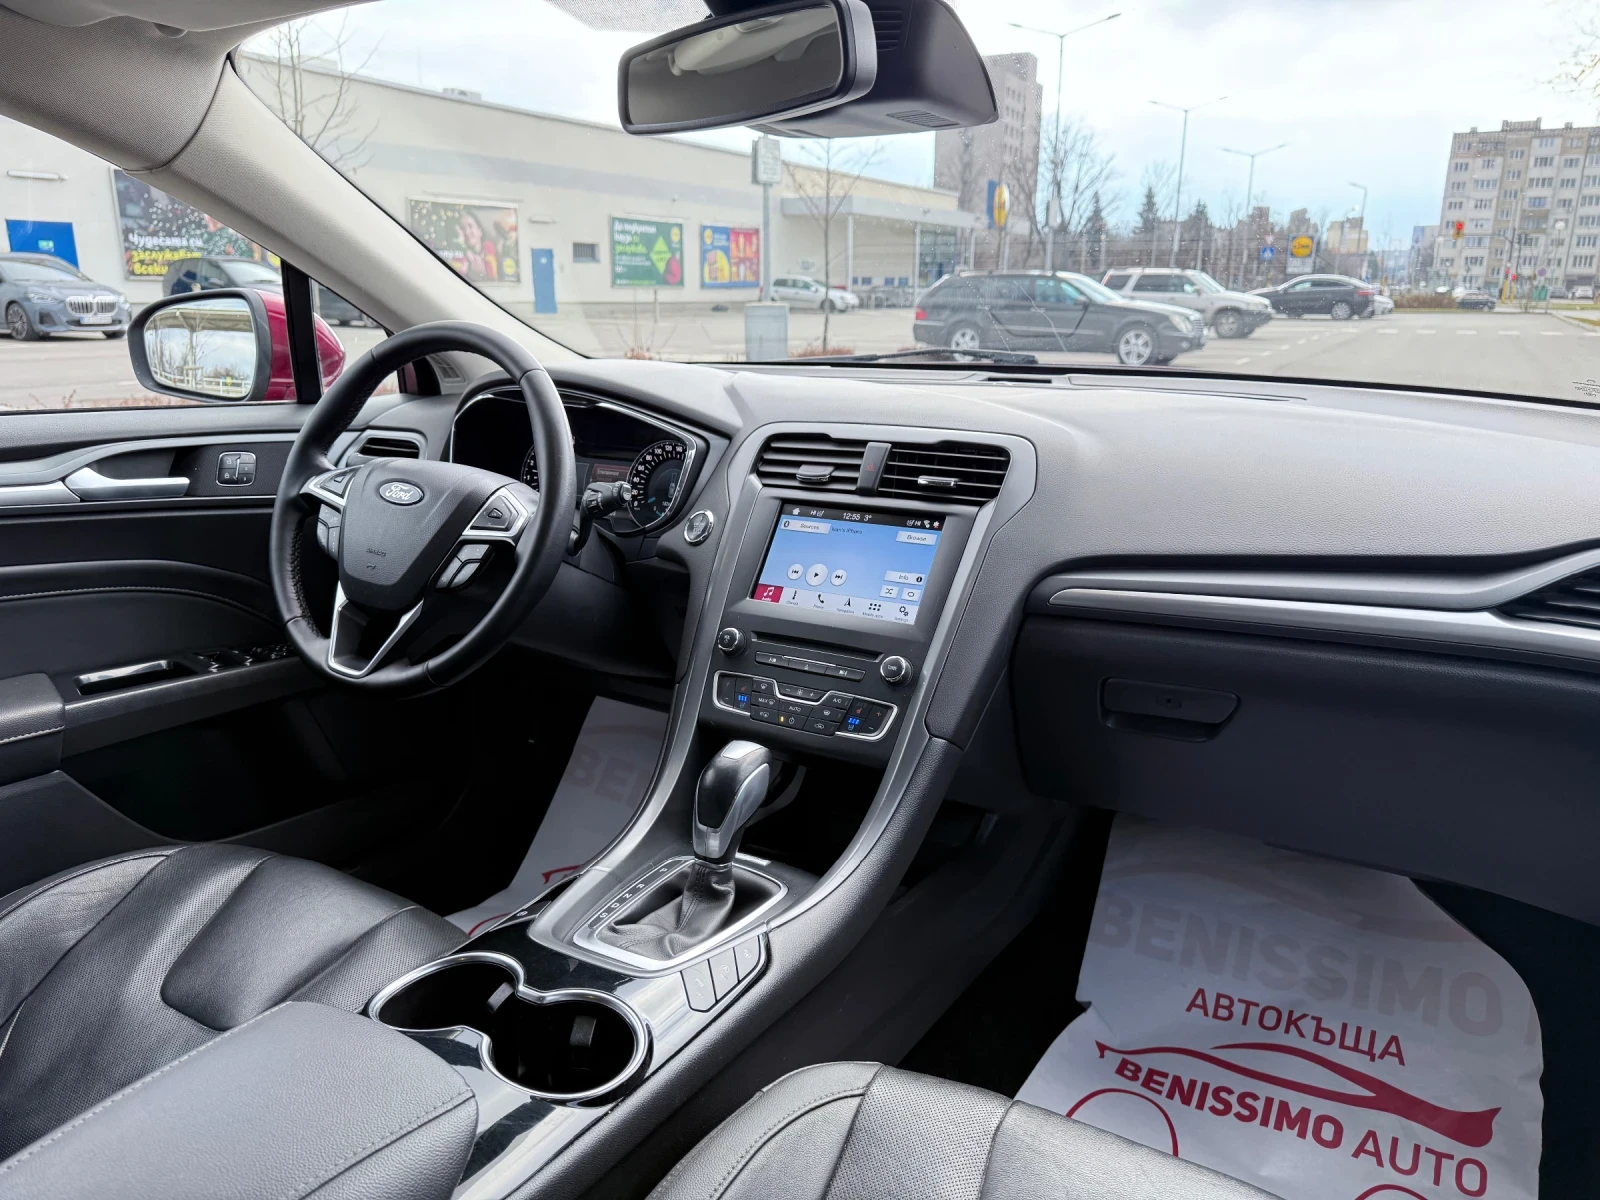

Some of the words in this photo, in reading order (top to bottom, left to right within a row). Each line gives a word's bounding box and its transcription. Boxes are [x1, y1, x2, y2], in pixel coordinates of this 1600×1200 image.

[385, 484, 414, 501] Ford
[842, 512, 861, 521] 12:55
[906, 534, 927, 542] Browse
[1090, 891, 1503, 1038] BENISSIMO
[1185, 987, 1406, 1066] АВТОКЪЩА
[1115, 1057, 1344, 1151] BENISSIMO
[1351, 1129, 1488, 1198] AUTO
